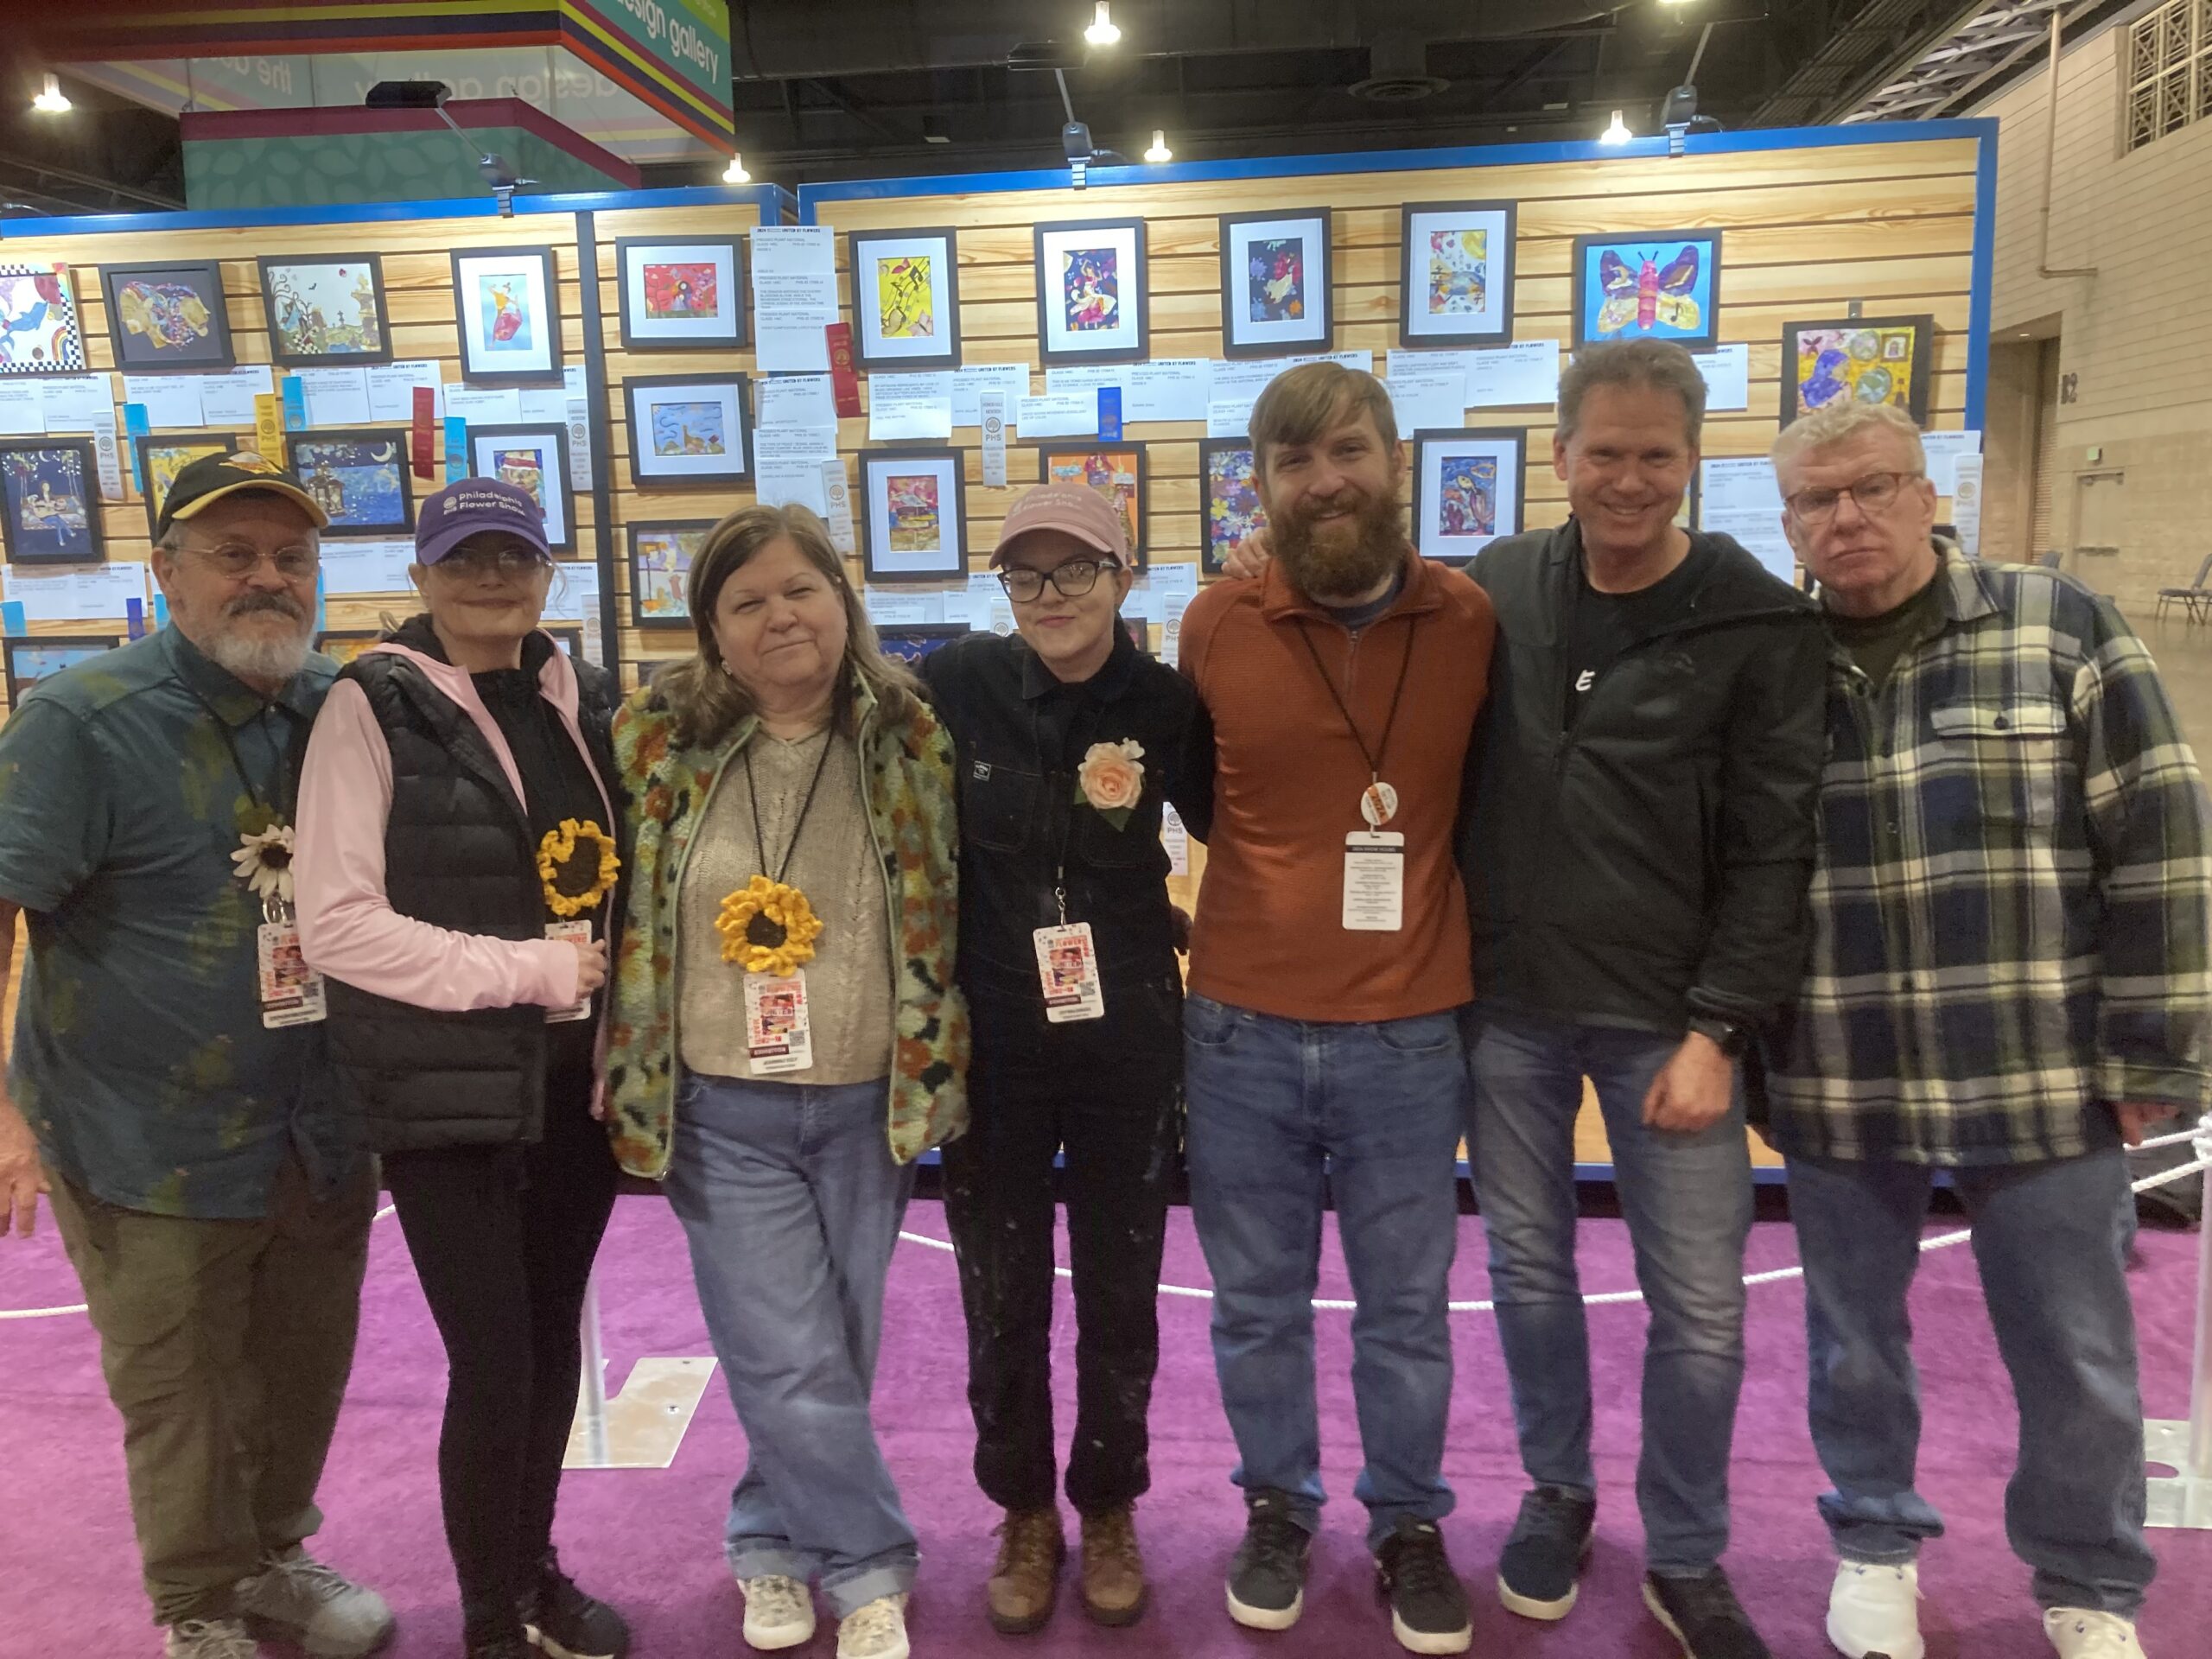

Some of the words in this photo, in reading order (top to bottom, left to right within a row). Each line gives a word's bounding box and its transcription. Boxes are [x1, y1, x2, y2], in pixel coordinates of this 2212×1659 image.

[616, 0, 666, 39] esign
[670, 18, 718, 84] gallery
[459, 490, 524, 507] Philadelphia
[830, 500, 847, 509] PHS
[459, 501, 497, 510] Flower
[499, 502, 526, 516] Show
